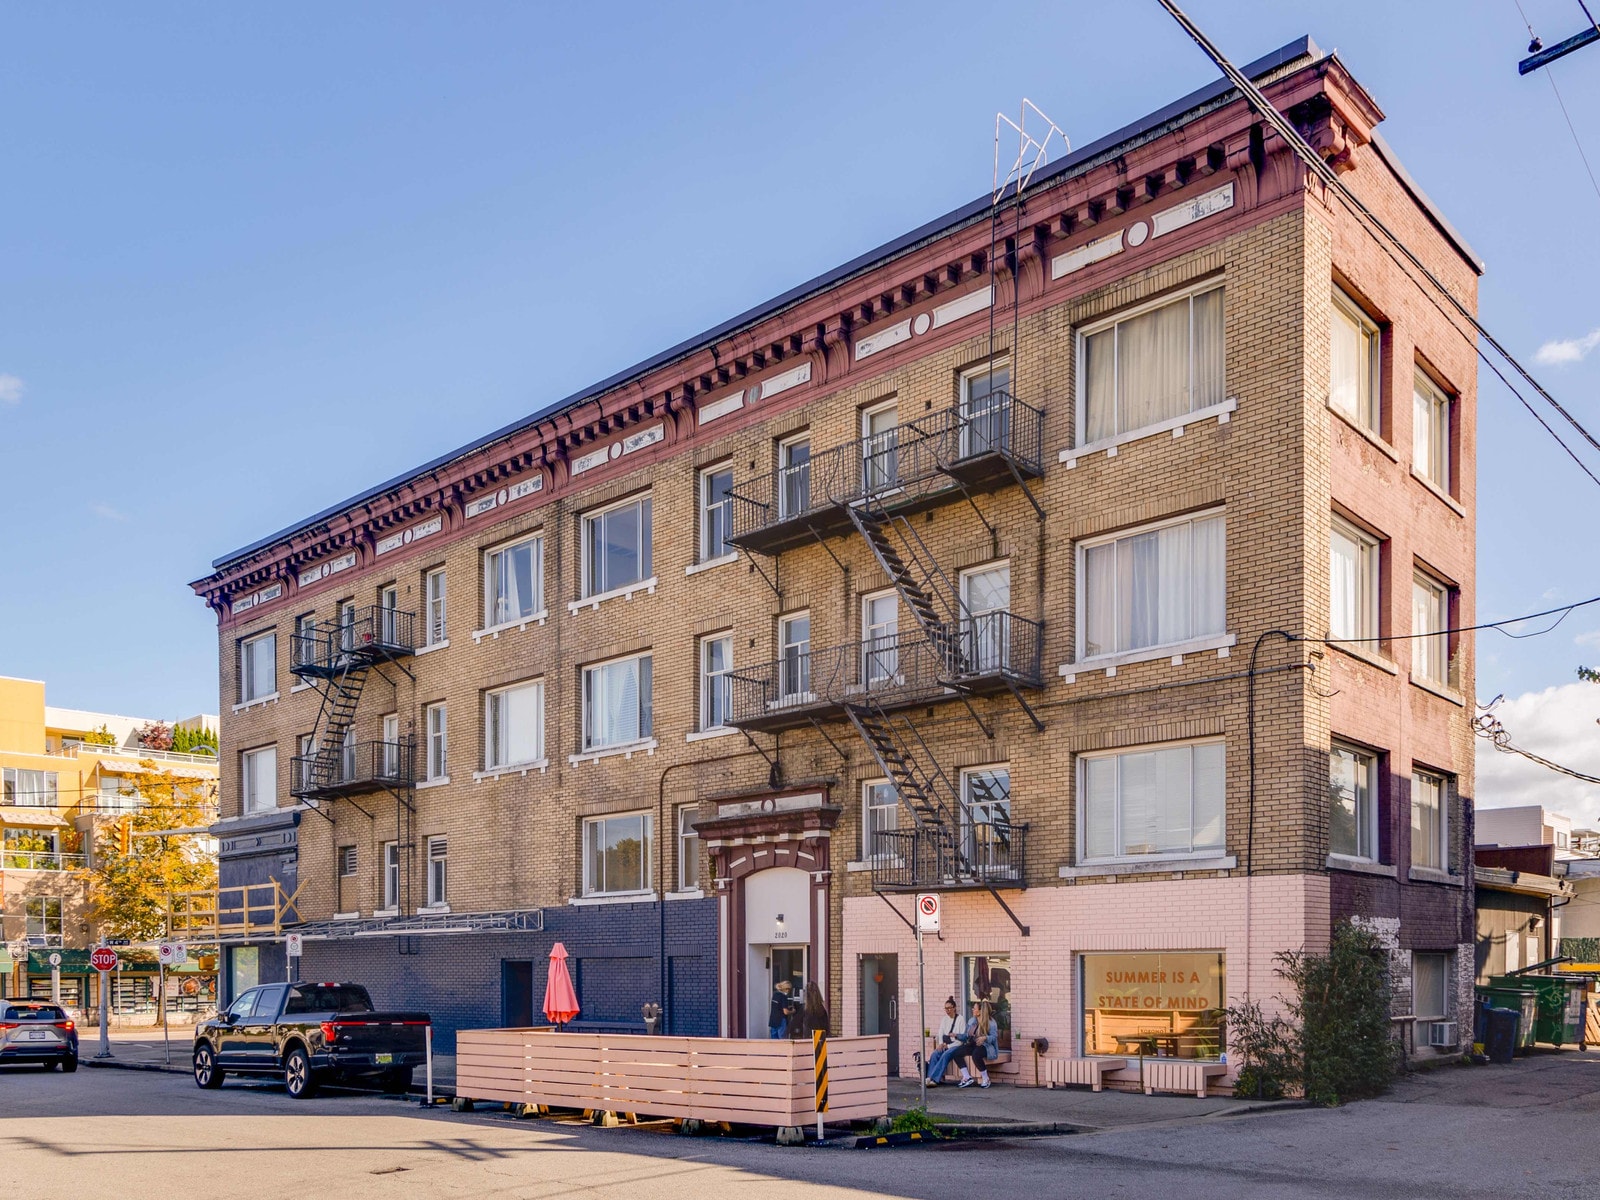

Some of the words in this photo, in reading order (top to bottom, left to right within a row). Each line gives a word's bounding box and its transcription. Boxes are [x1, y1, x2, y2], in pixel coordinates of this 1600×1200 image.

[92, 954, 116, 965] STOP
[1106, 971, 1167, 984] SUMMER
[1172, 971, 1185, 984] IS
[1190, 971, 1200, 984] A
[1098, 995, 1139, 1008] STATE
[1143, 996, 1162, 1008] OF
[1167, 997, 1209, 1009] MIND
